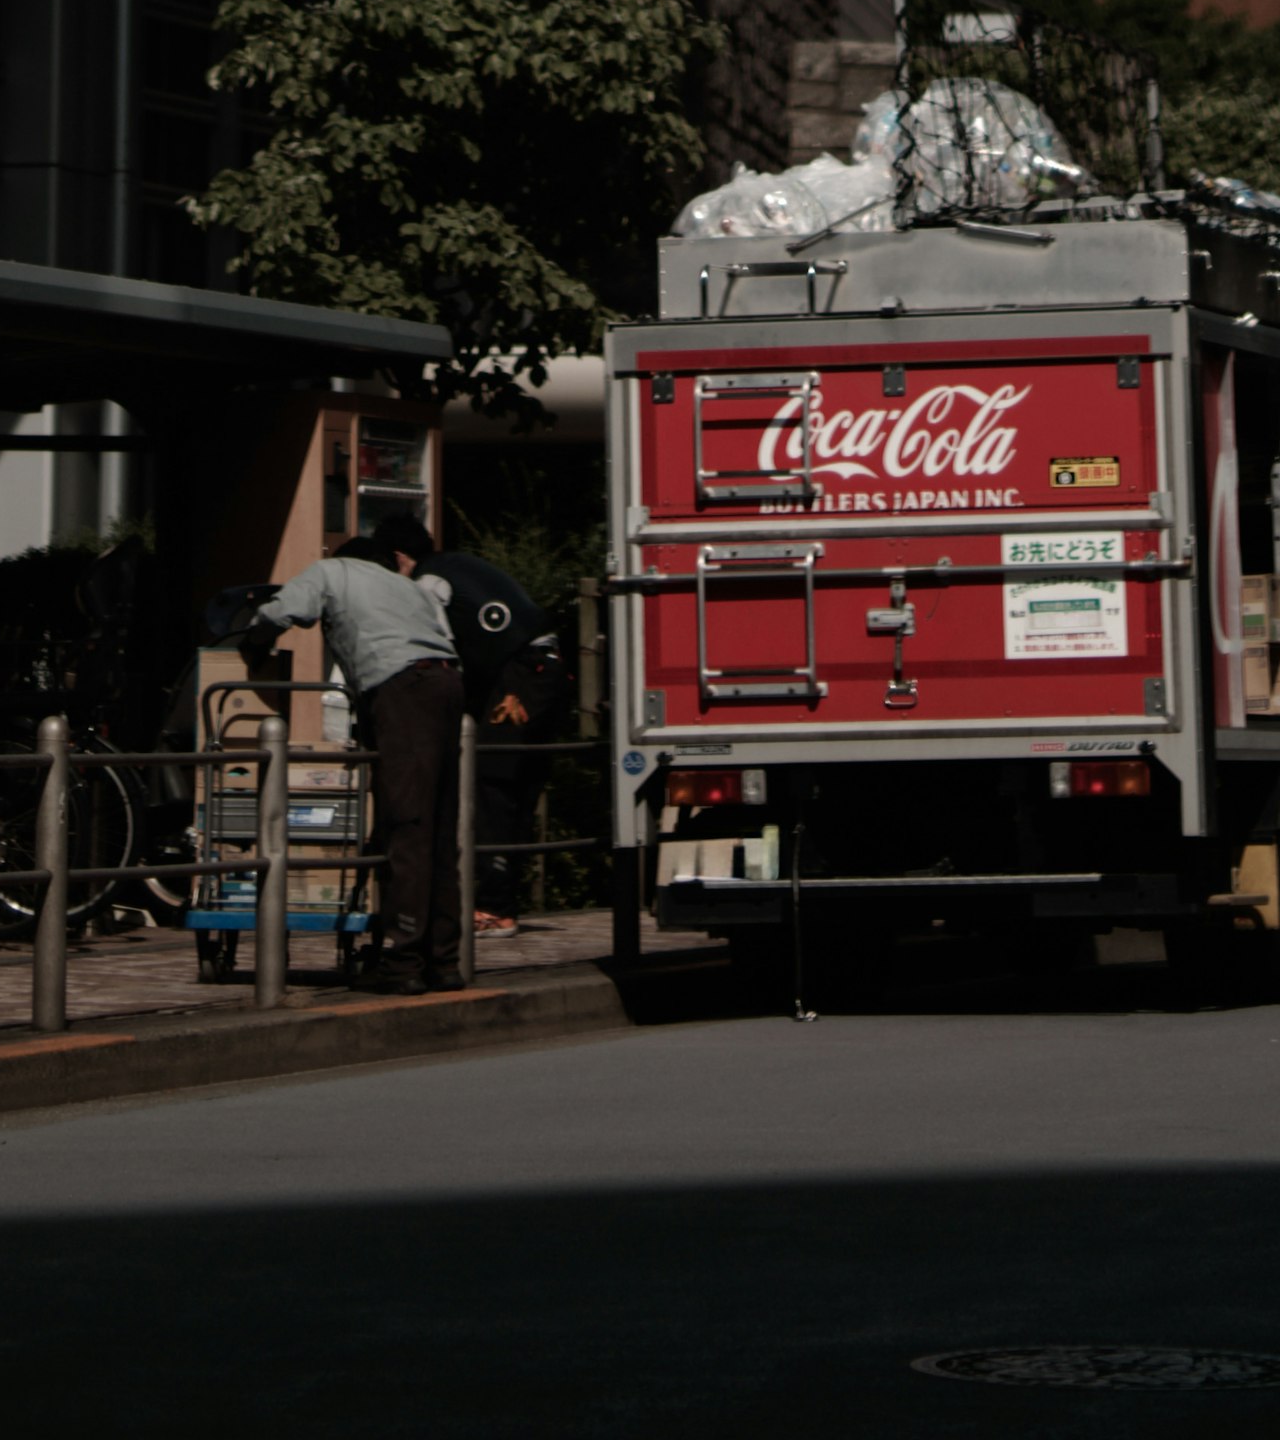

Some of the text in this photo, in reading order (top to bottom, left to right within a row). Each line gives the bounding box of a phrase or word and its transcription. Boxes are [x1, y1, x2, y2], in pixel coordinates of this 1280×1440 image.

[757, 383, 1033, 481] Coca-Cola
[974, 487, 1025, 509] INC.
[1009, 538, 1116, 563] お先にどうぞ
